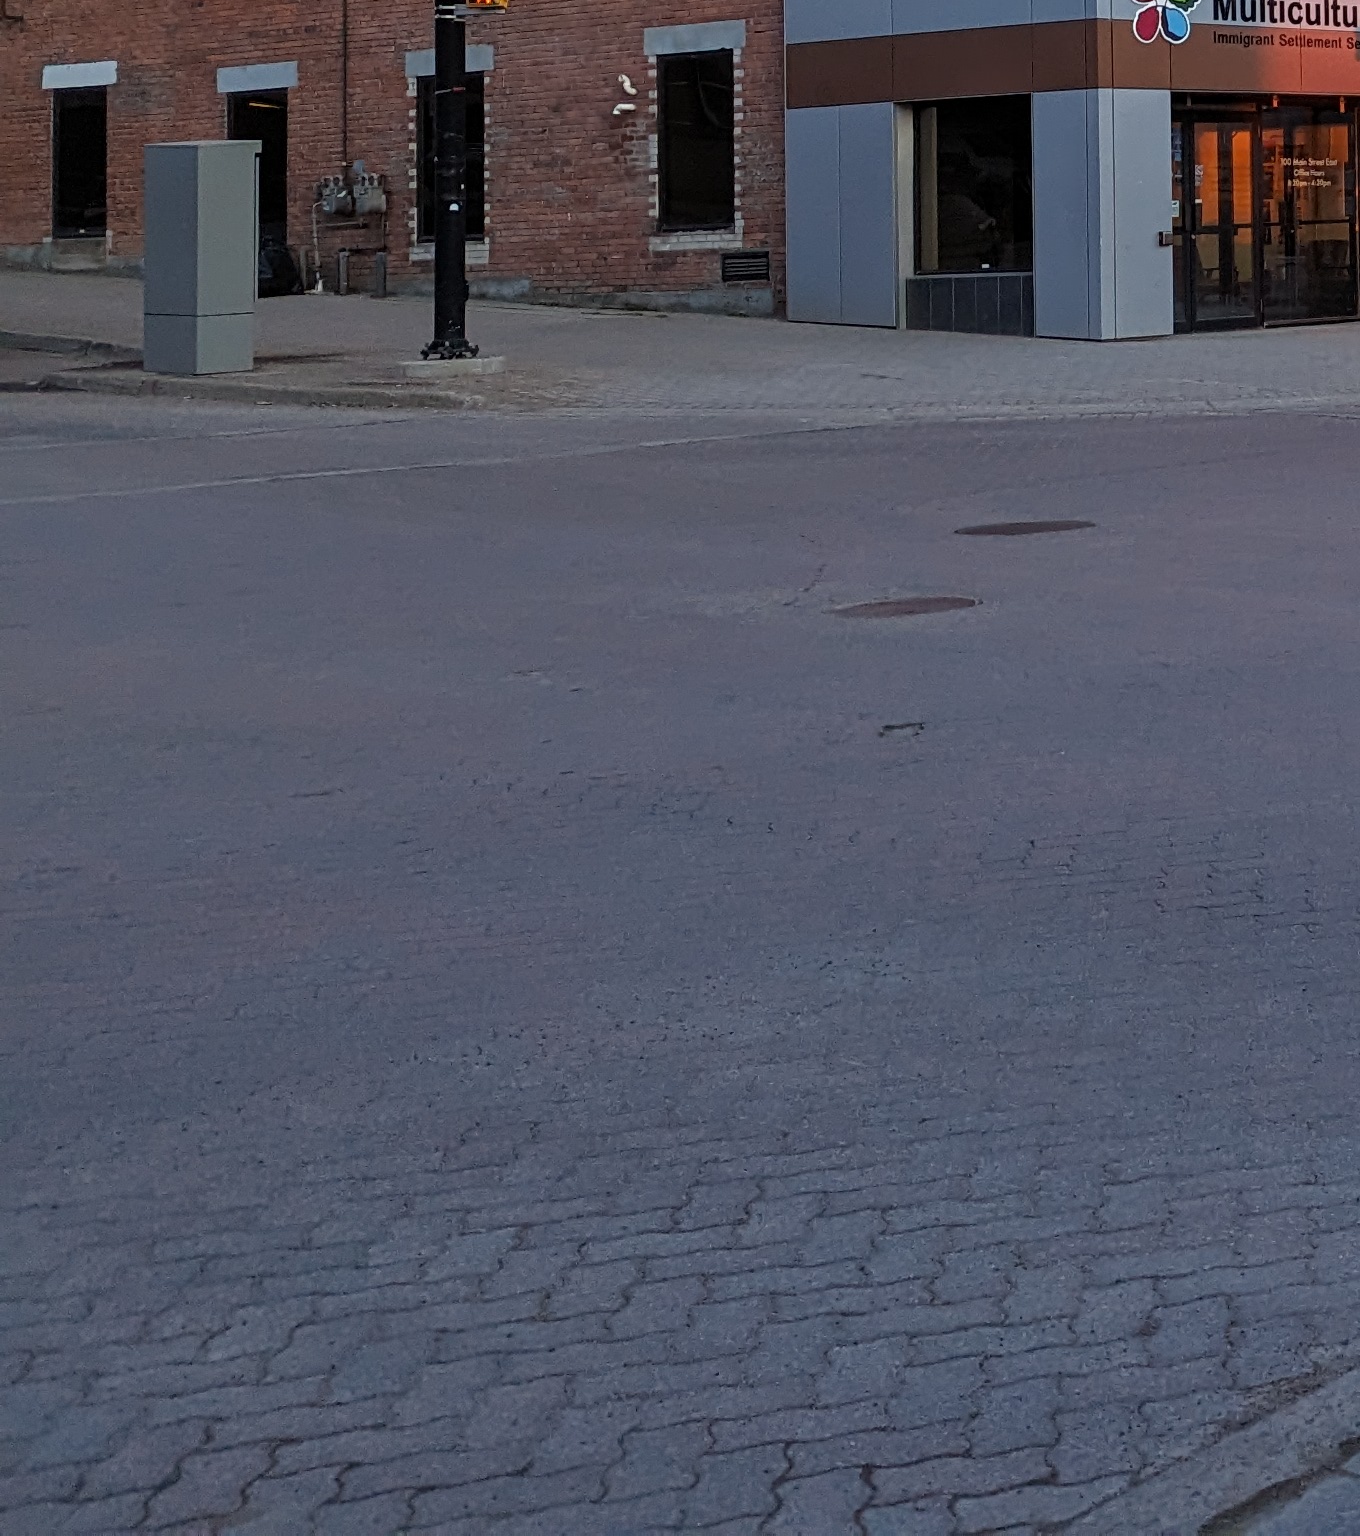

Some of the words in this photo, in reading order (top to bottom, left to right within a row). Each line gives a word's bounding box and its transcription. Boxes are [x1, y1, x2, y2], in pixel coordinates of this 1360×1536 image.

[1213, 31, 1275, 48] Immigrant
[1279, 33, 1343, 50] Settlement
[1280, 157, 1292, 166] 100
[1292, 157, 1308, 166] Main
[1308, 157, 1325, 166] Street
